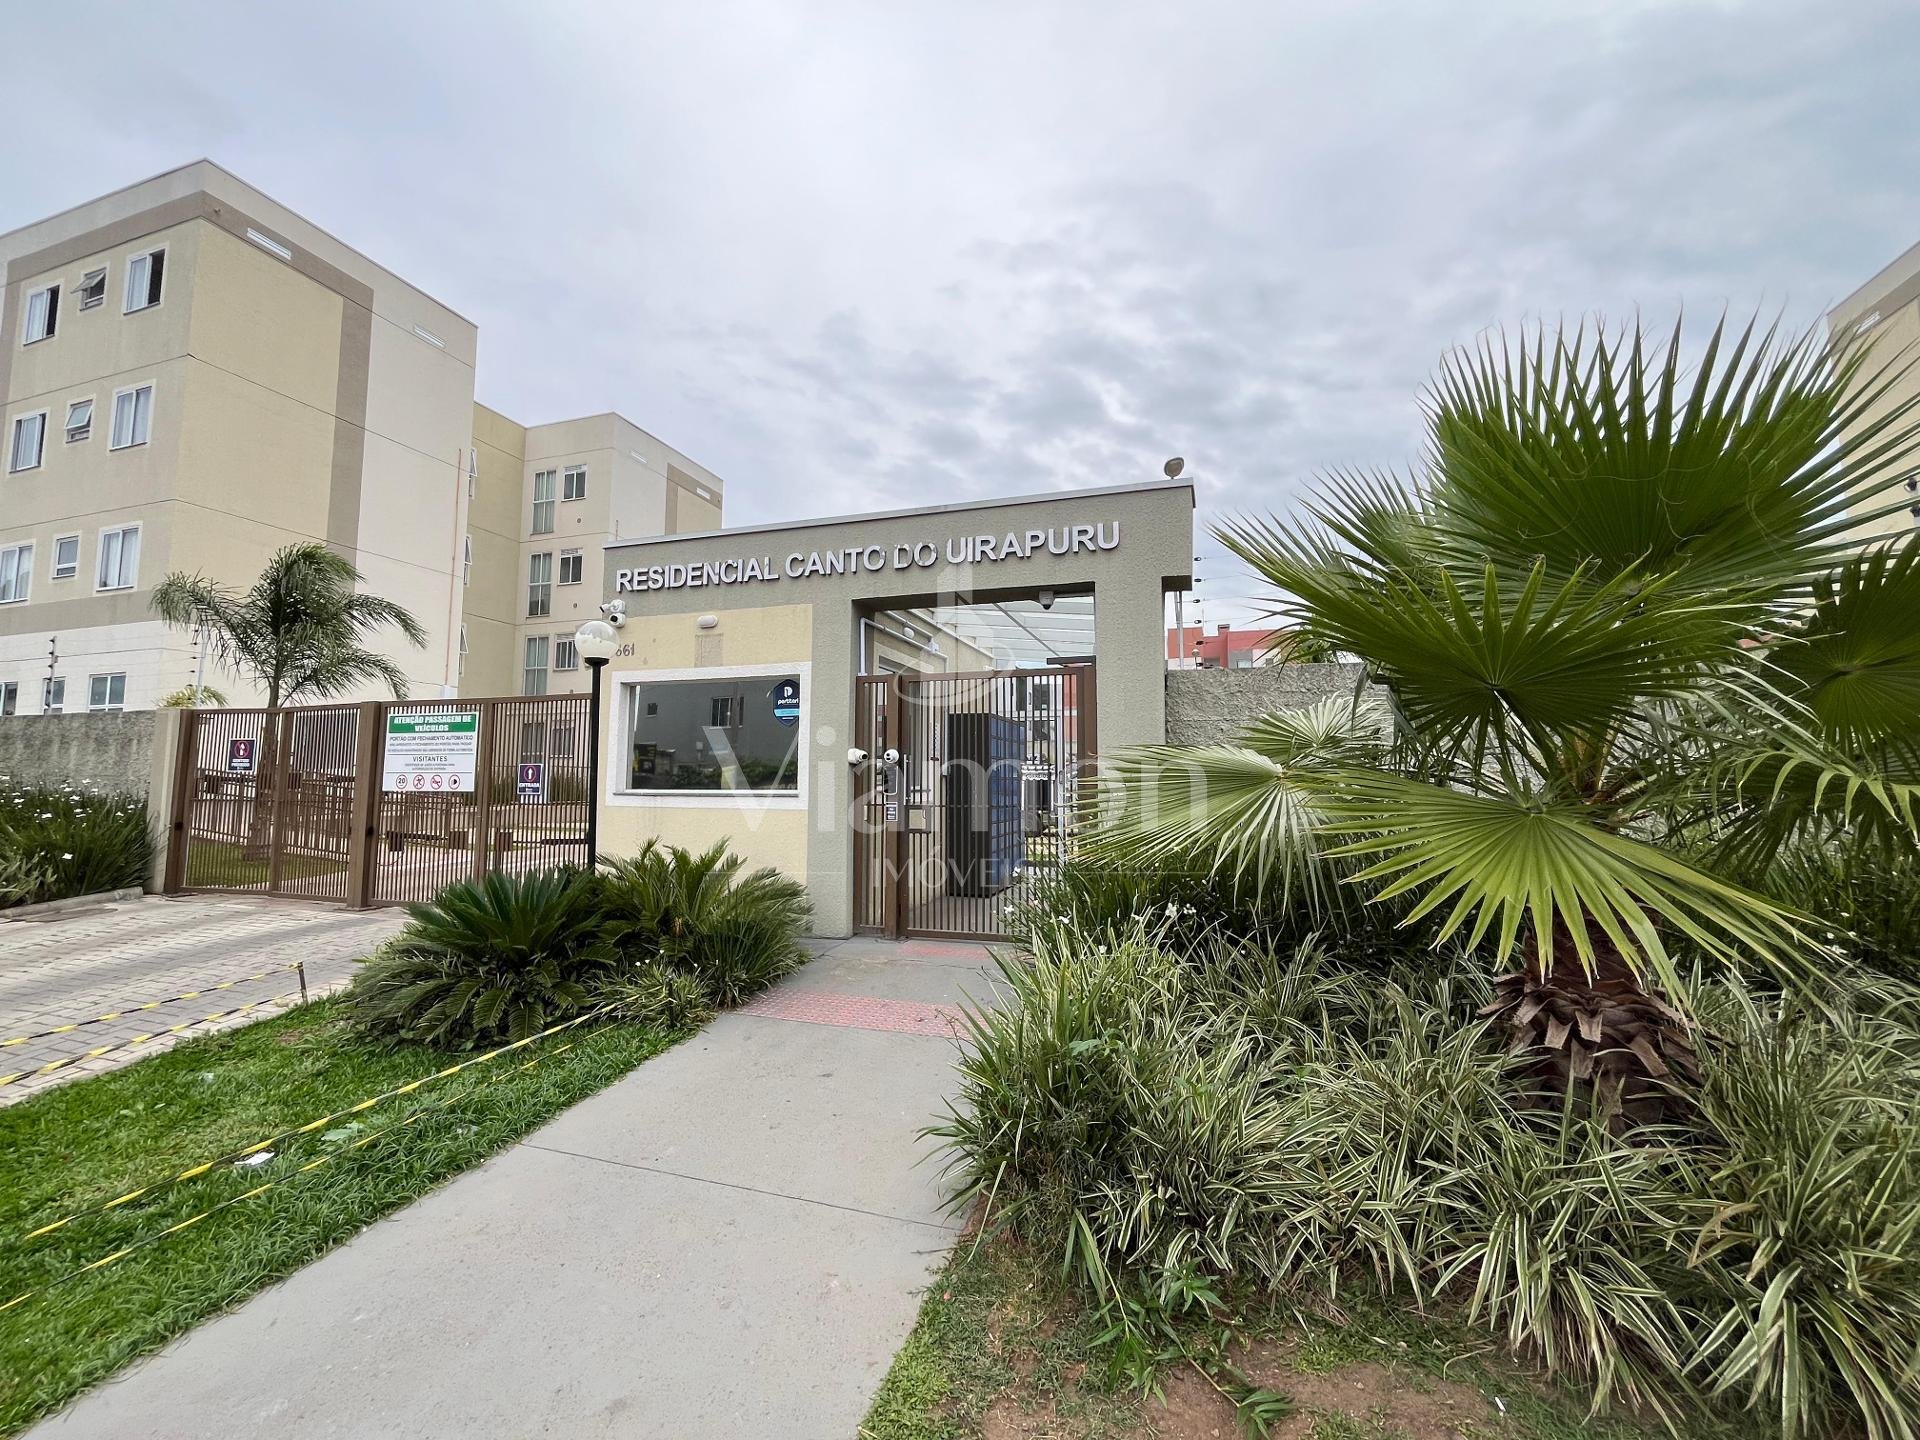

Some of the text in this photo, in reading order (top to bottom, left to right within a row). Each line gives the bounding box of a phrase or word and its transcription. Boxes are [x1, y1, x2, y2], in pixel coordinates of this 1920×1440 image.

[616, 521, 1119, 593] RESIDENCIAL CANTO DO UIRAPURU
[393, 714, 472, 724] ATENÇÃO PASSAGEM DE
[415, 724, 449, 732] VEÍCULOS
